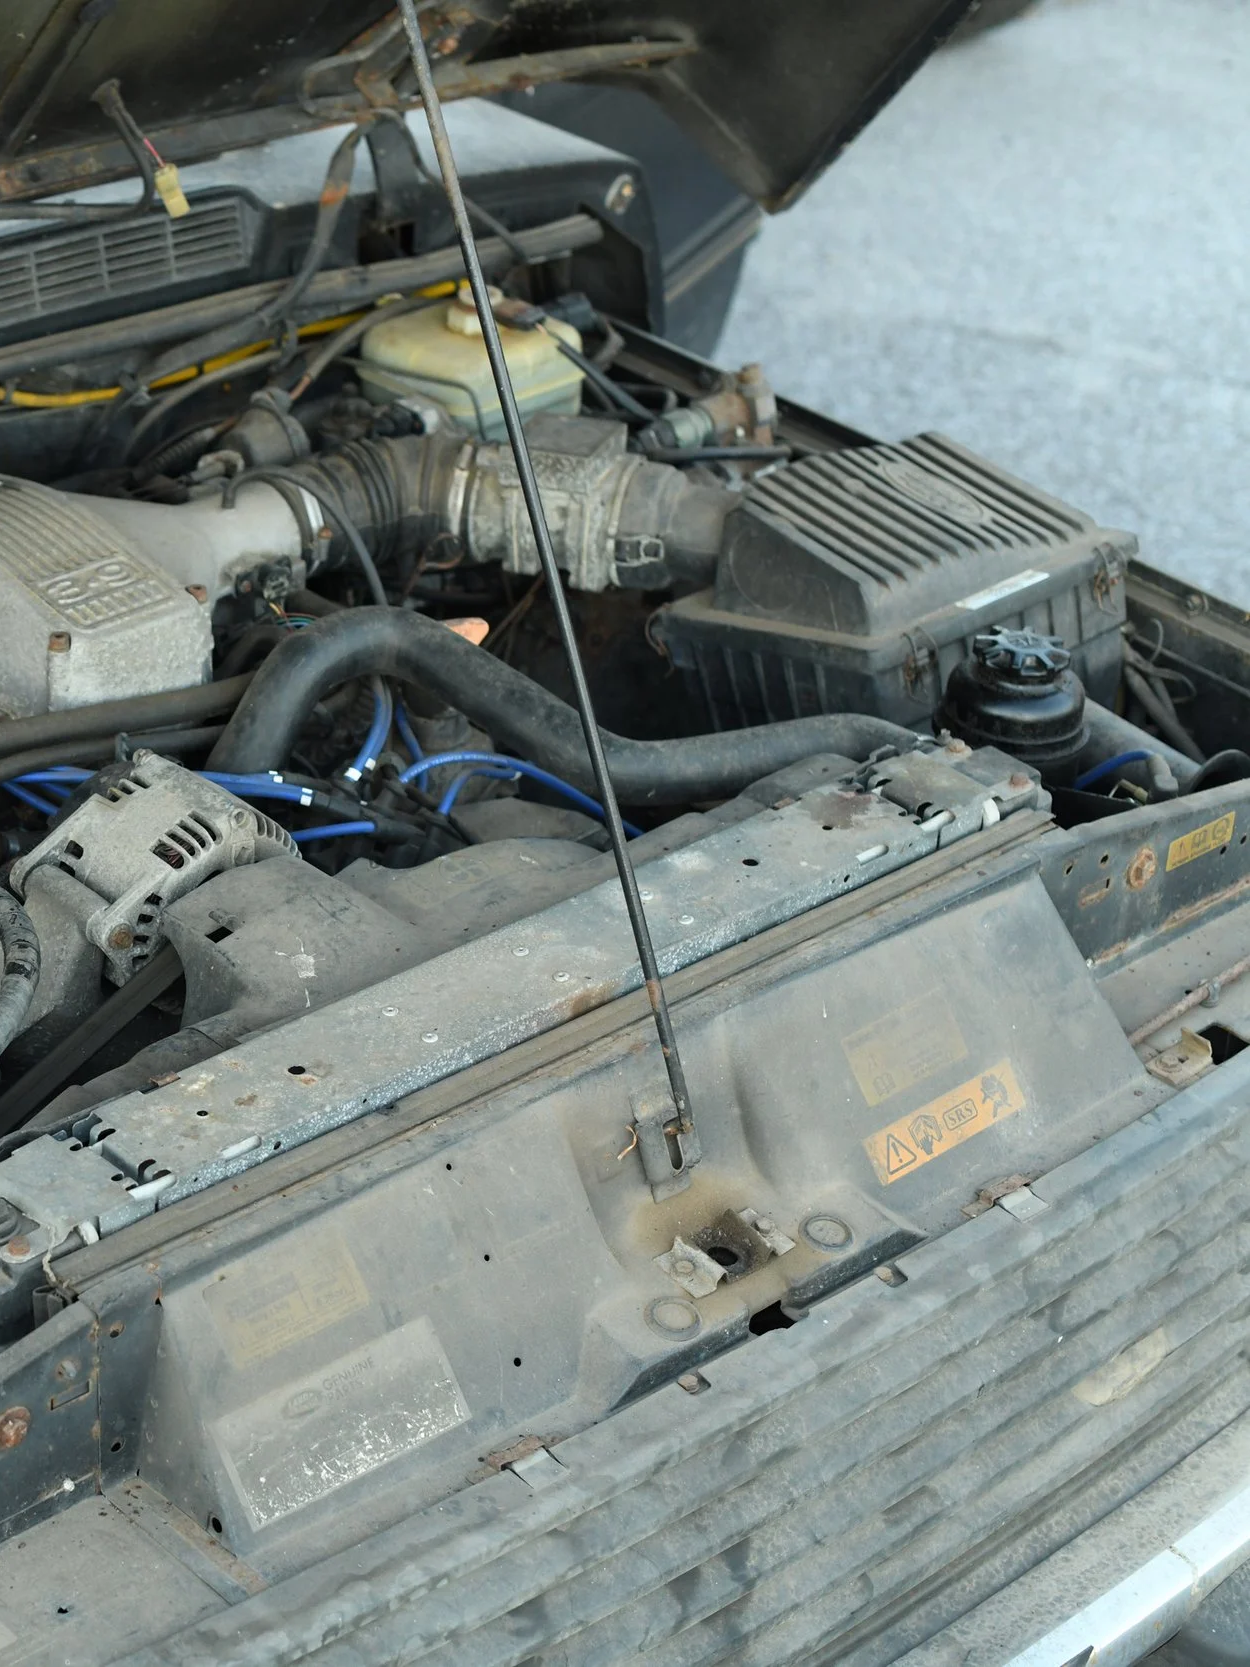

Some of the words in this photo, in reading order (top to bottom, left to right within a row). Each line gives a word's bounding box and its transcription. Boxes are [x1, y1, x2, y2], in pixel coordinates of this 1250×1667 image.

[47, 562, 136, 605] 3.9
[948, 1102, 973, 1126] SRS
[323, 1356, 375, 1391] GENUINE
